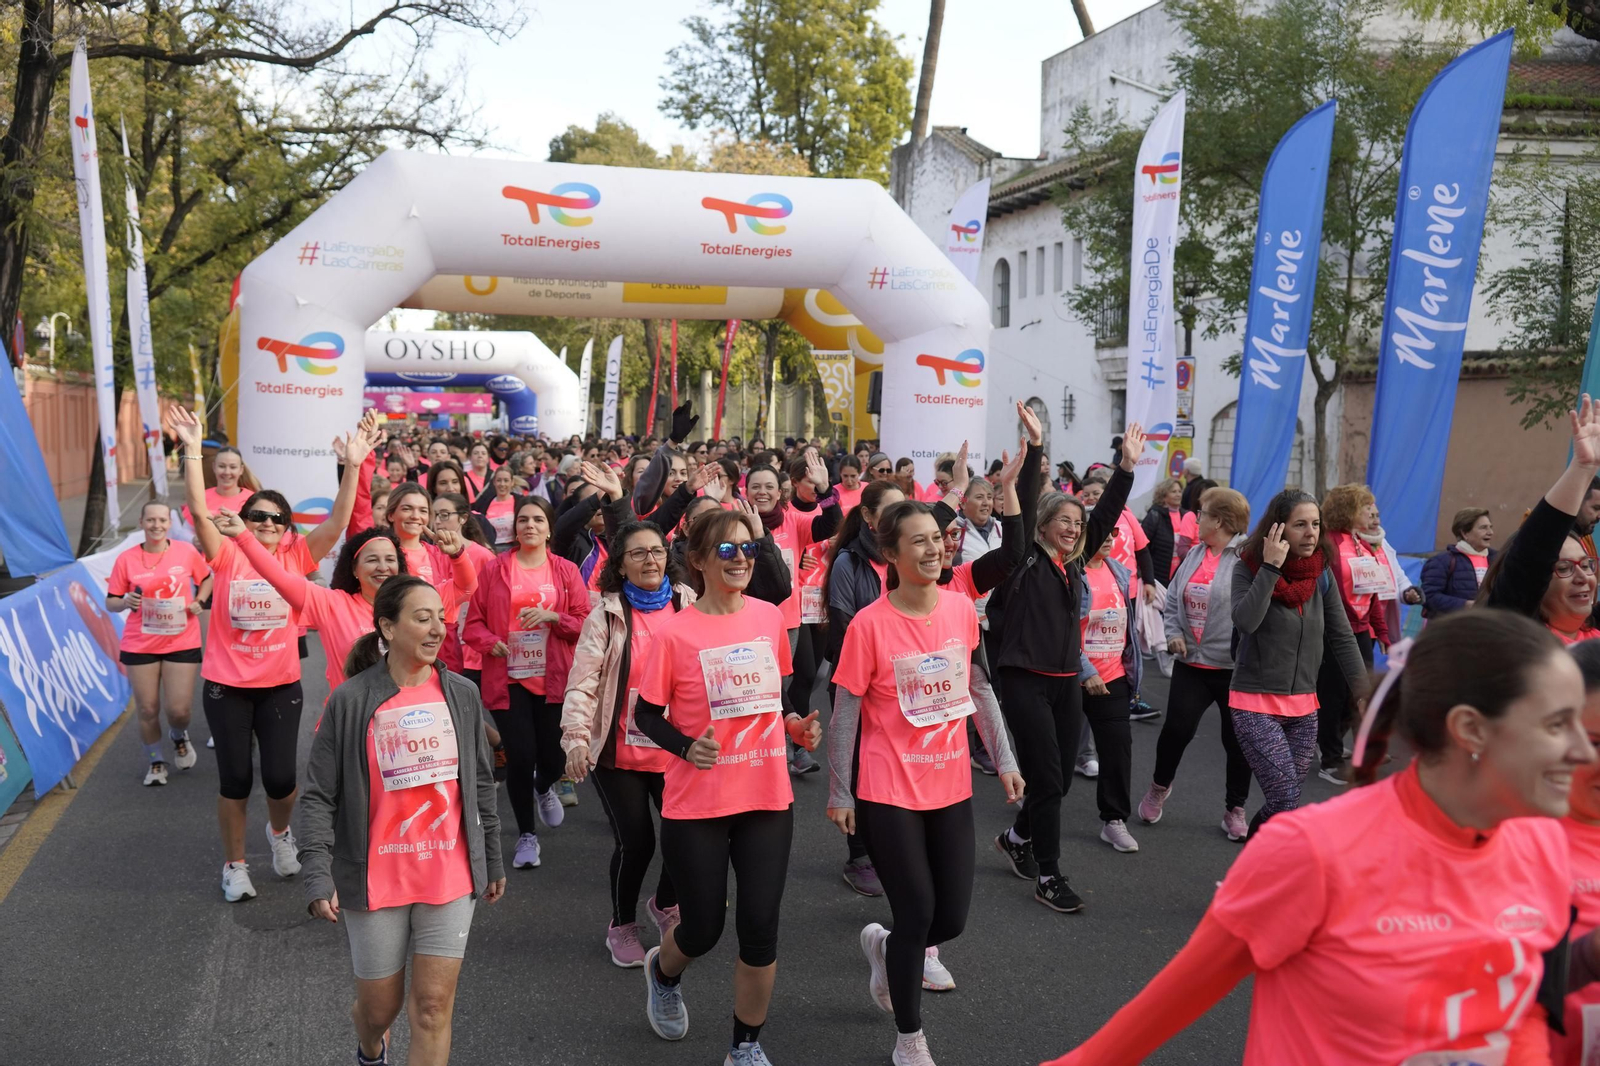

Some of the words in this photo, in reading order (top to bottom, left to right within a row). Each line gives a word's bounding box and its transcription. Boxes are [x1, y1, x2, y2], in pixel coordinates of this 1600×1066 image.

[501, 233, 600, 251] TotalEnergies
[700, 243, 792, 259] TotalEnergies
[1392, 183, 1467, 370] Marlene
[528, 289, 542, 298] de
[544, 290, 592, 301] Deportes
[1249, 230, 1306, 390] Marlene
[385, 338, 495, 361] OYSHO
[255, 381, 344, 398] TotalEnergies
[914, 394, 984, 407] TotalEnergies
[253, 444, 337, 458] totalenergies.e
[250, 600, 271, 609] 016
[1191, 602, 1206, 610] 016
[1101, 626, 1117, 634] 016
[523, 649, 543, 658] 016
[732, 672, 761, 686] 016
[923, 680, 951, 696] 016
[719, 706, 745, 715] OYSHO
[407, 736, 439, 753] 016
[418, 754, 435, 763] 6092
[716, 752, 748, 765] CARRERA
[749, 749, 758, 759] DE
[760, 748, 769, 757] LA
[750, 758, 764, 767] 2025
[902, 753, 934, 763] CARRERA
[944, 751, 950, 761] LA
[392, 774, 421, 786] OYSHO
[378, 843, 415, 855] CARRERA
[416, 840, 427, 852] DE
[428, 840, 438, 850] LA
[418, 851, 433, 860] 2025
[1376, 912, 1452, 935] OYSHO
